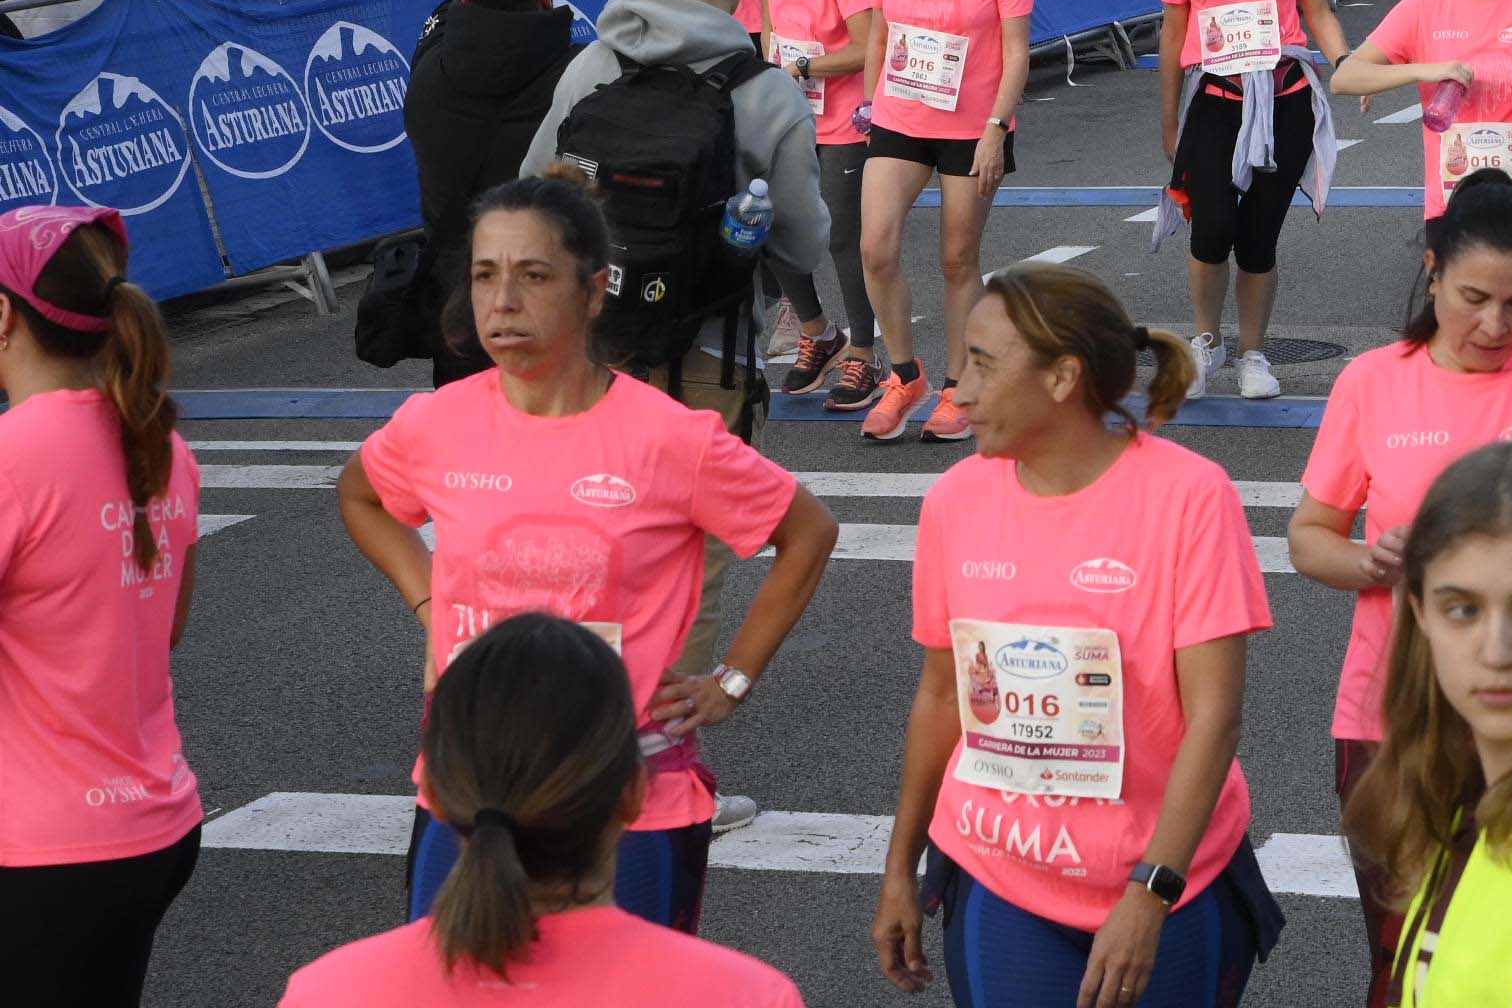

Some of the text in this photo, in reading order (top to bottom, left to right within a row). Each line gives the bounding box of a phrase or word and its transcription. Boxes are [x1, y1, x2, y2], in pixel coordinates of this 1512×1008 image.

[1226, 30, 1252, 43] 016
[1231, 42, 1248, 52] 3189
[326, 58, 400, 84] CENTRAL LECHERA
[910, 57, 935, 72] 016
[912, 72, 928, 80] 7863
[201, 99, 305, 152] ASTURIANA
[69, 126, 182, 189] ASTURIANA
[1471, 156, 1501, 168] 016
[1387, 431, 1449, 449] OYSHO
[445, 471, 513, 492] OYSHO
[962, 560, 1016, 581] OYSHO
[1075, 570, 1132, 585] ASTURIANA
[1001, 652, 1062, 670] ASTURIANA
[1074, 648, 1110, 661] SUMA
[1005, 691, 1061, 717] 016
[1011, 723, 1054, 739] 17952
[978, 738, 1107, 759] CARRERA DE LA MUJER 2023
[974, 759, 1110, 783] OYSHO Santander
[956, 800, 1081, 865] SUMA
